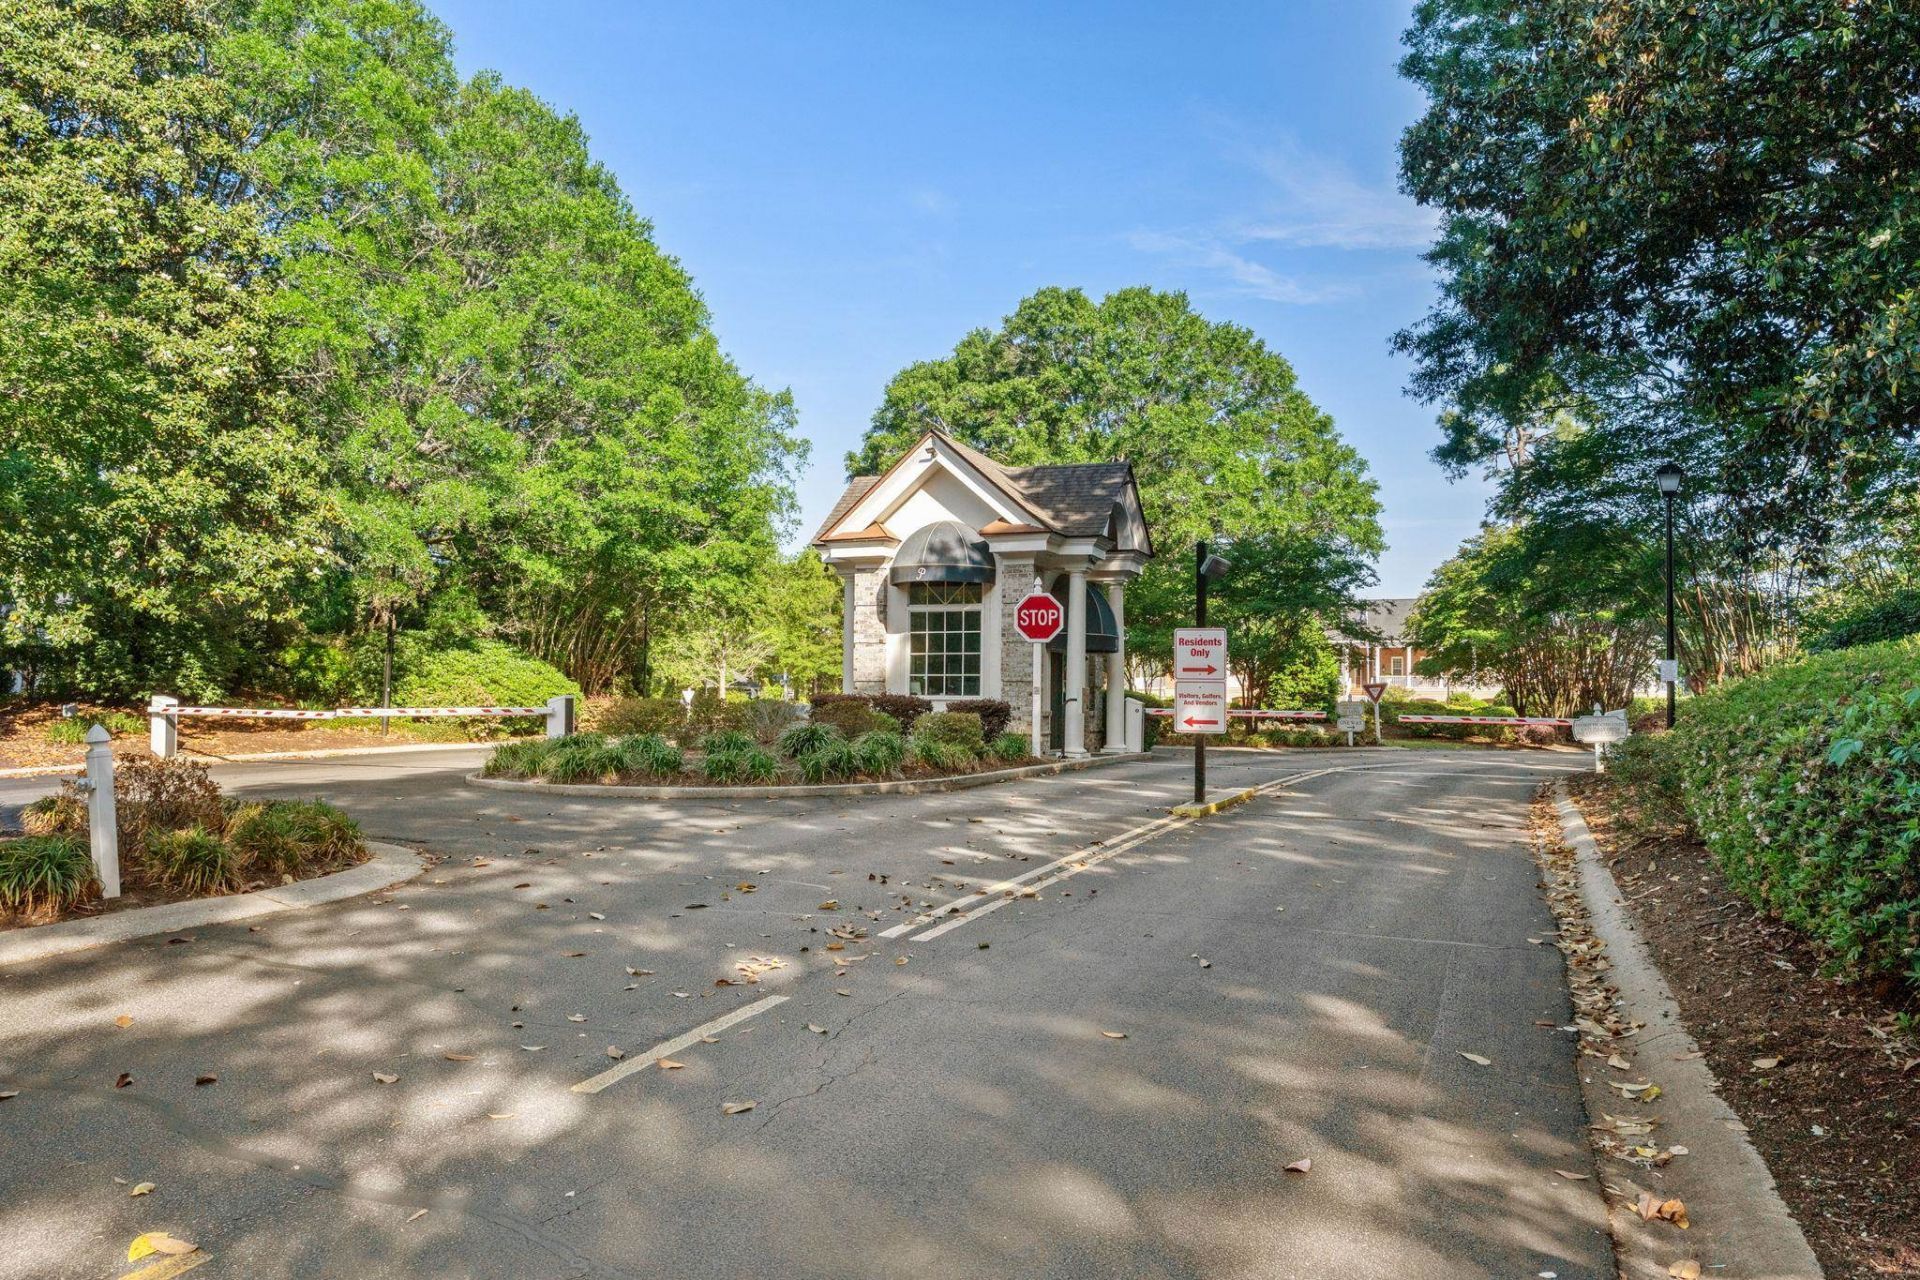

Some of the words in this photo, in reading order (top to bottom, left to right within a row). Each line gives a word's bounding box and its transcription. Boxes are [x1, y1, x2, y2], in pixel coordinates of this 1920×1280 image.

[1019, 609, 1058, 626] STOP
[1178, 637, 1222, 646] Residents
[1190, 648, 1210, 659] Only
